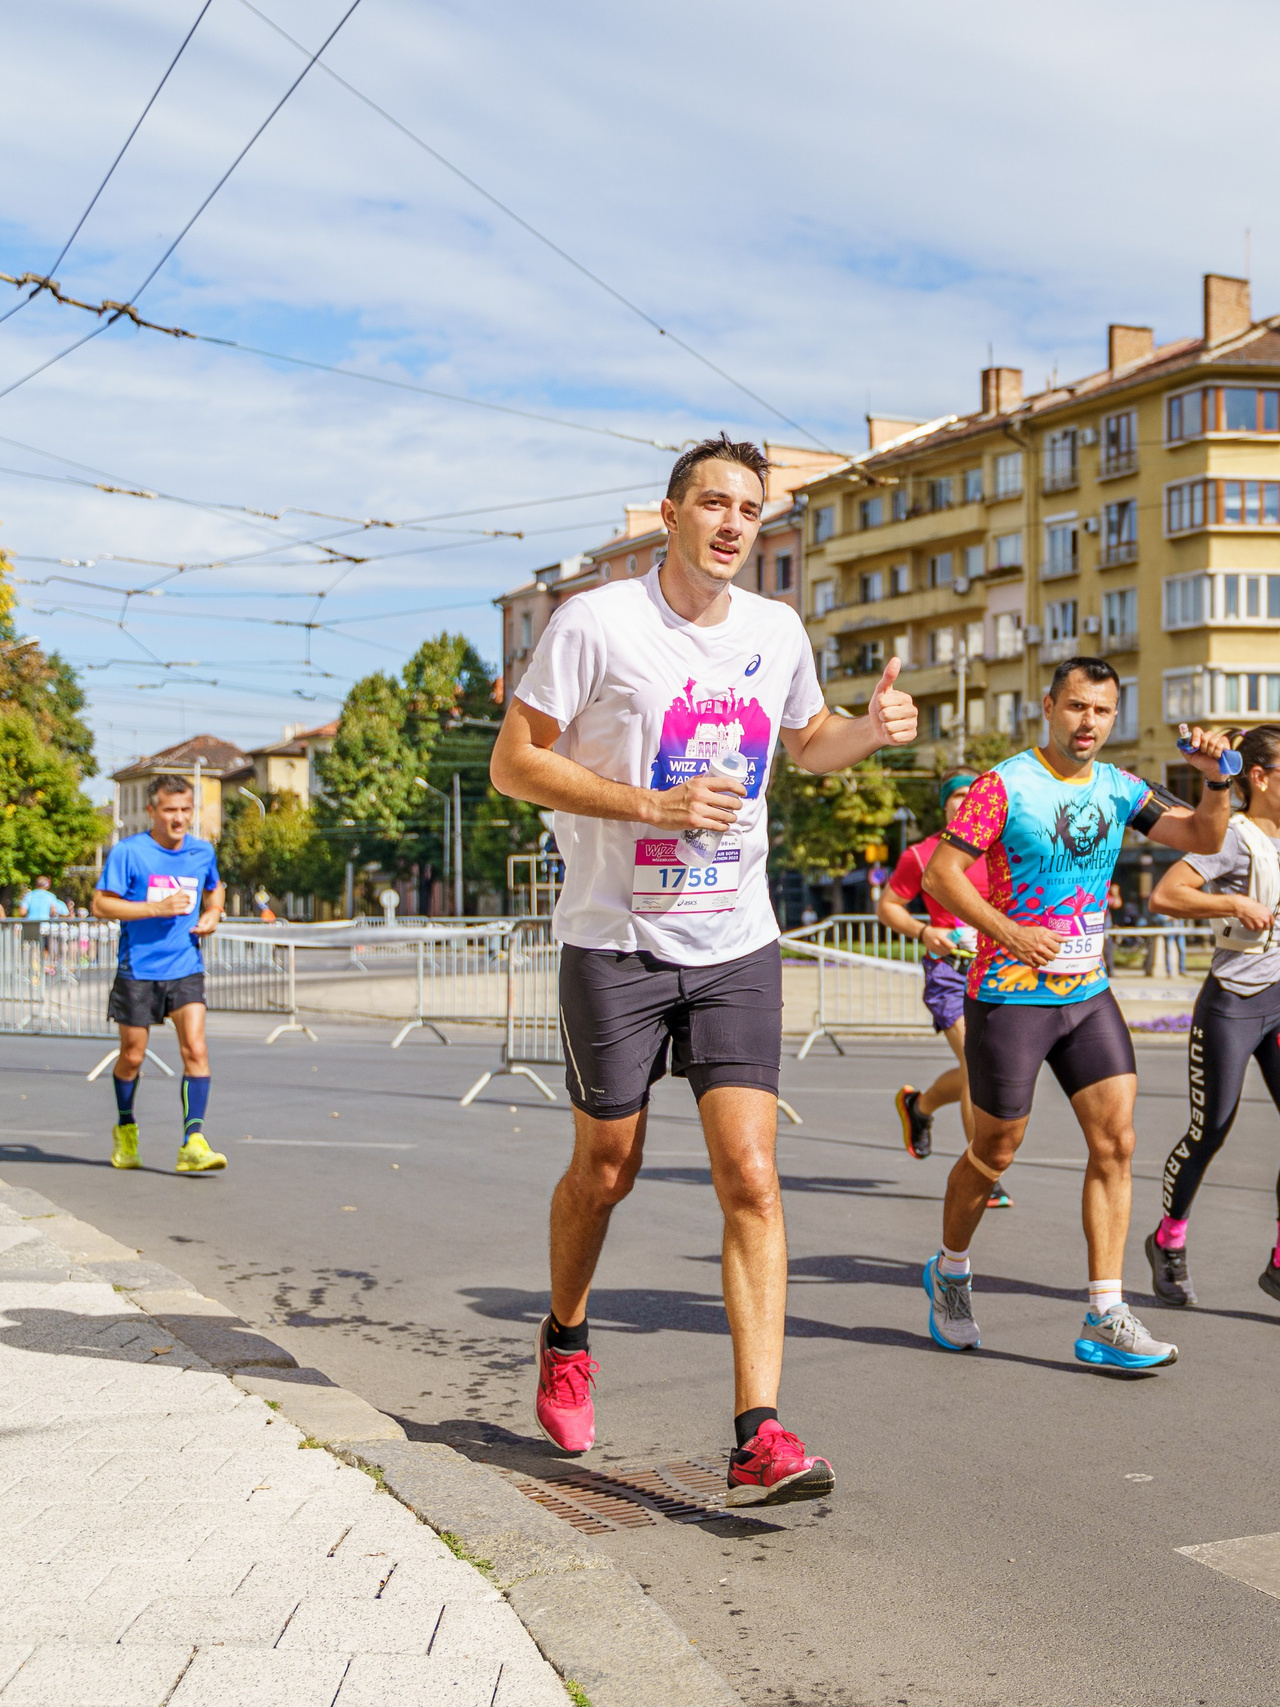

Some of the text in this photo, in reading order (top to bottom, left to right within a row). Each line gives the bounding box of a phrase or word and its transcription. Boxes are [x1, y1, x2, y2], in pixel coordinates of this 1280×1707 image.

[669, 760, 697, 773] WIZZ
[659, 867, 718, 888] 1758
[1060, 937, 1093, 954] 556
[1189, 1043, 1206, 1142] UNDER
